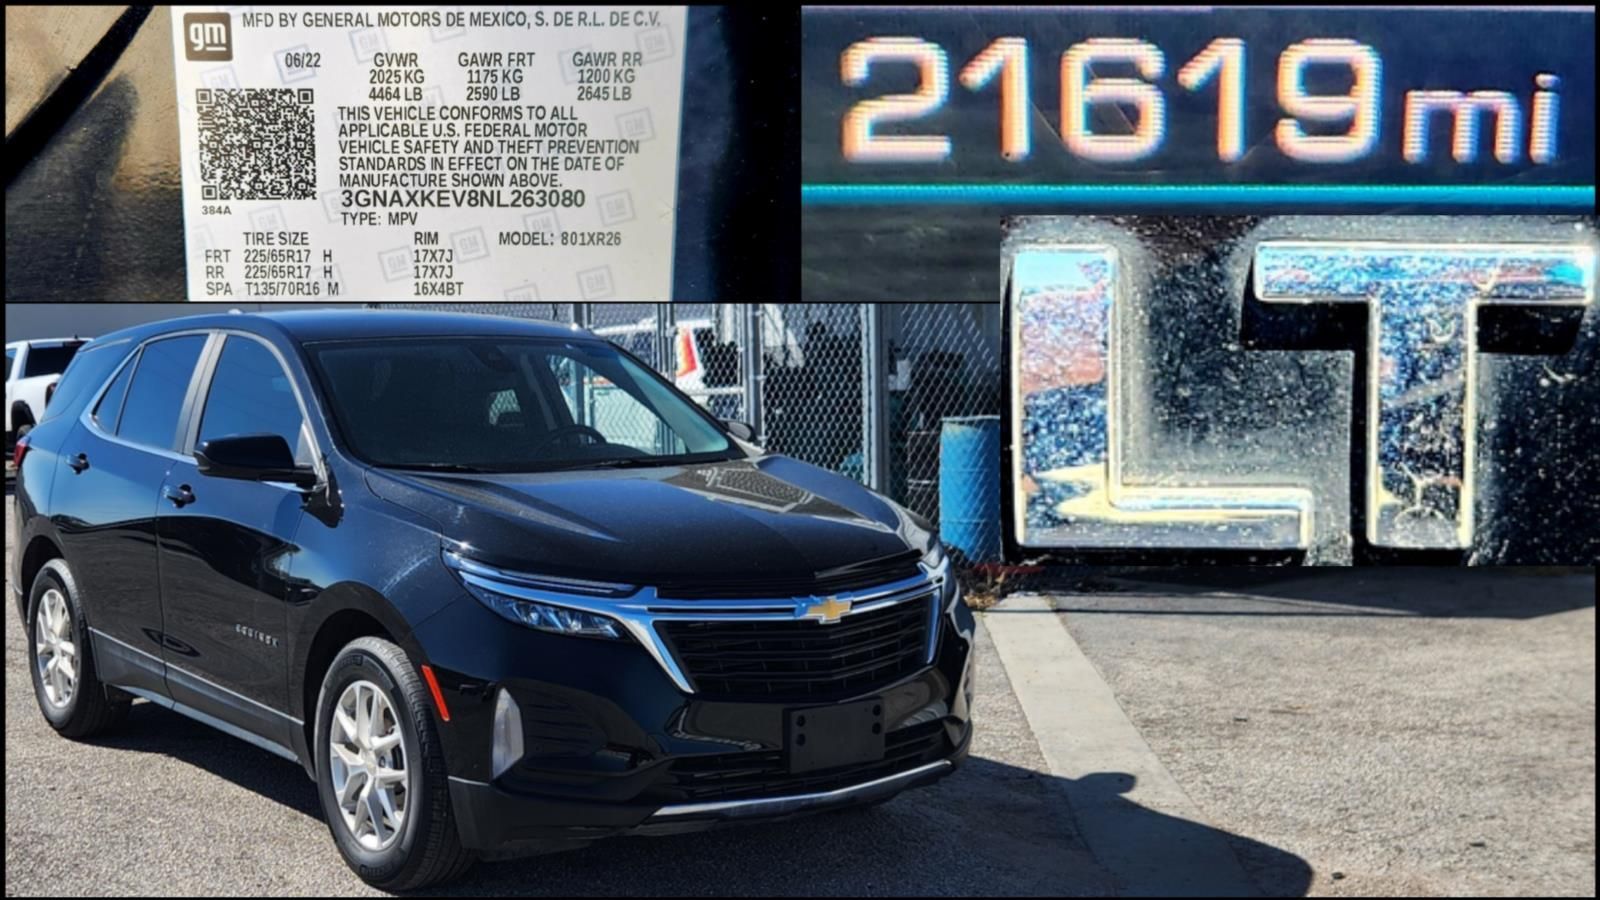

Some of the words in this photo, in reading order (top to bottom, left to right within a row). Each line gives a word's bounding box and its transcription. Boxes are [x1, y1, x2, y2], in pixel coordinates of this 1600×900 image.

[243, 13, 274, 27] MFD
[279, 13, 297, 27] BY
[303, 13, 374, 27] GENERAL
[378, 12, 441, 27] MOTORS
[446, 12, 465, 27] DE
[469, 11, 530, 29] MEXICO,
[535, 11, 549, 27] S.
[553, 11, 573, 27] DE
[578, 11, 604, 27] R.L.
[610, 11, 629, 27] DE
[633, 11, 661, 27] C.V.
[190, 23, 226, 51] gm
[285, 53, 321, 68] 06/22
[374, 53, 418, 67] GVWR
[458, 52, 502, 67] GAWR
[508, 52, 535, 67] FRT
[572, 52, 617, 67] GAWR
[622, 52, 642, 67] RR
[369, 69, 401, 84] 2025
[405, 69, 425, 84] KG
[467, 69, 498, 84] 1175
[502, 69, 523, 84] KG
[578, 69, 610, 83] 1200
[614, 69, 635, 83] KG
[368, 87, 401, 101] 4464
[405, 87, 422, 101] LB
[466, 87, 498, 101] 2590
[502, 87, 520, 101] LB
[577, 87, 610, 100] 2645
[613, 87, 632, 100] LB
[841, 36, 1383, 162] 21619
[1402, 73, 1561, 164] mi
[338, 106, 370, 120] THIS
[374, 106, 435, 120] VEHICLE
[439, 106, 523, 120] CONFORMS
[527, 106, 546, 120] TO
[550, 106, 578, 120] ALL
[339, 124, 428, 137] APPLICABLE
[433, 124, 459, 137] U.S.
[465, 124, 530, 137] FEDERAL
[535, 124, 587, 137] MOTOR
[339, 141, 400, 154] VEHICLE
[403, 141, 458, 154] SAFETY
[464, 140, 493, 154] AND
[498, 140, 543, 154] THEFT
[549, 140, 639, 154] PREVENTION
[339, 157, 426, 171] STANDARDS
[431, 157, 444, 171] IN
[450, 157, 502, 171] EFFECT
[507, 157, 527, 171] ON
[532, 157, 559, 171] THE
[564, 157, 601, 171] DATE
[605, 157, 624, 171] OF
[340, 174, 447, 187] MANUFACTURE
[451, 174, 504, 187] SHOWN
[509, 174, 562, 187] ABOVE.
[342, 190, 585, 207] 3GNAXKEV8NL263080
[202, 206, 232, 215] 384A
[341, 212, 381, 226] TYPE:
[388, 212, 418, 226] MPV
[243, 232, 275, 245] TIRE
[278, 232, 309, 245] SIZE
[414, 232, 439, 245] RIM
[499, 232, 554, 246] MODEL:
[561, 232, 621, 246] 801XR26
[205, 250, 231, 263] FRT
[244, 250, 311, 263] 225/65R17
[323, 250, 332, 263] H
[414, 250, 453, 263] 17X7J
[206, 266, 224, 279] RR
[244, 266, 311, 279] 225/65R17
[324, 266, 332, 279] H
[414, 266, 453, 279] 17X7J
[206, 282, 232, 296] SPA
[246, 282, 320, 296] T135/70R16
[328, 282, 338, 296] M
[414, 282, 464, 296] 16X4BT
[1011, 241, 1594, 548] LT
